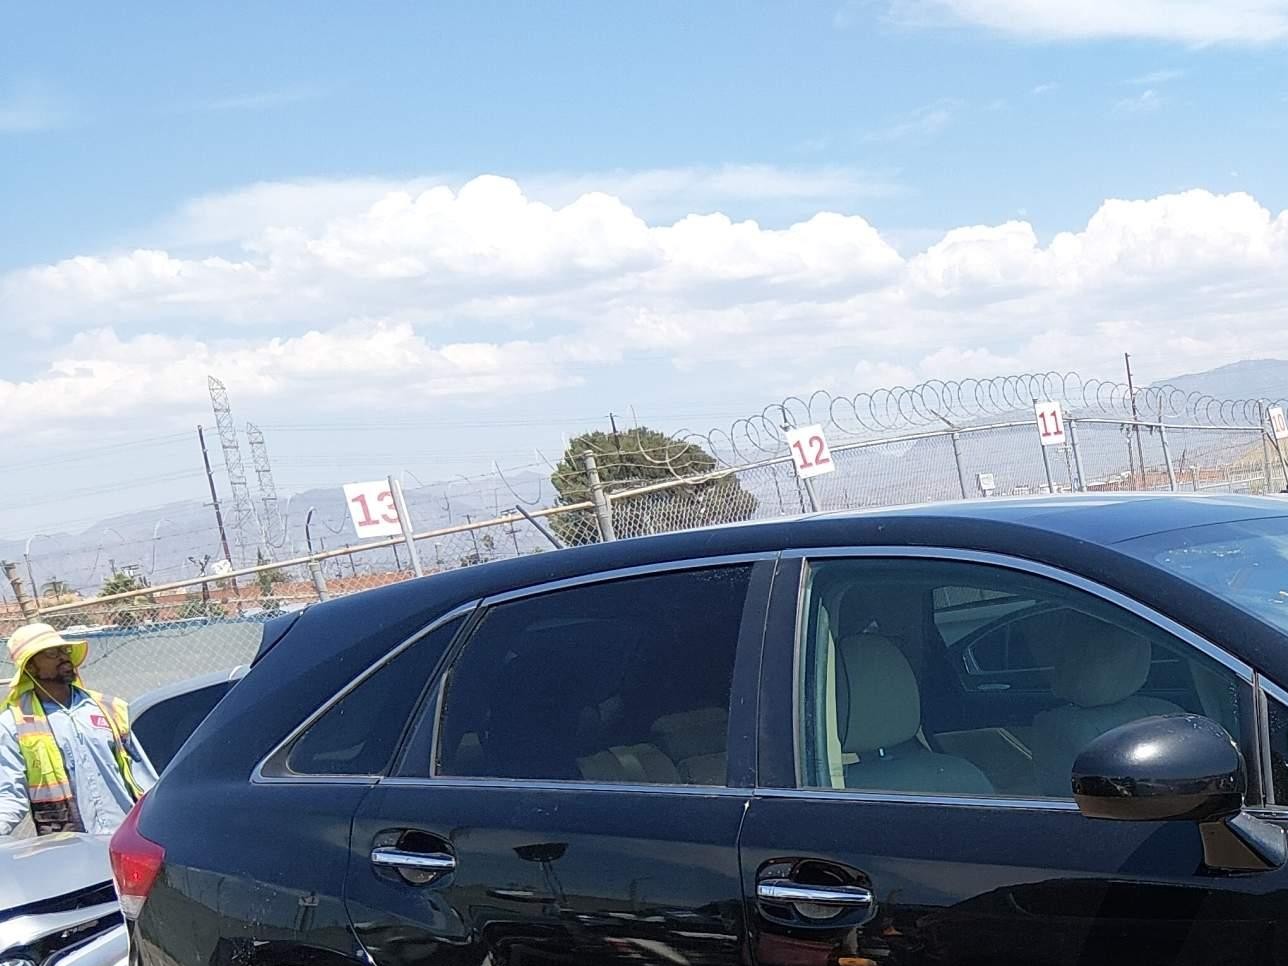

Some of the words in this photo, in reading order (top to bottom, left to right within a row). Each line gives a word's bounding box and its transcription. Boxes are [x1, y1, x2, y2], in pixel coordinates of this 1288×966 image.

[1038, 410, 1063, 437] 11
[1271, 413, 1286, 432] 10
[792, 435, 830, 469] 12
[351, 490, 400, 527] 13
